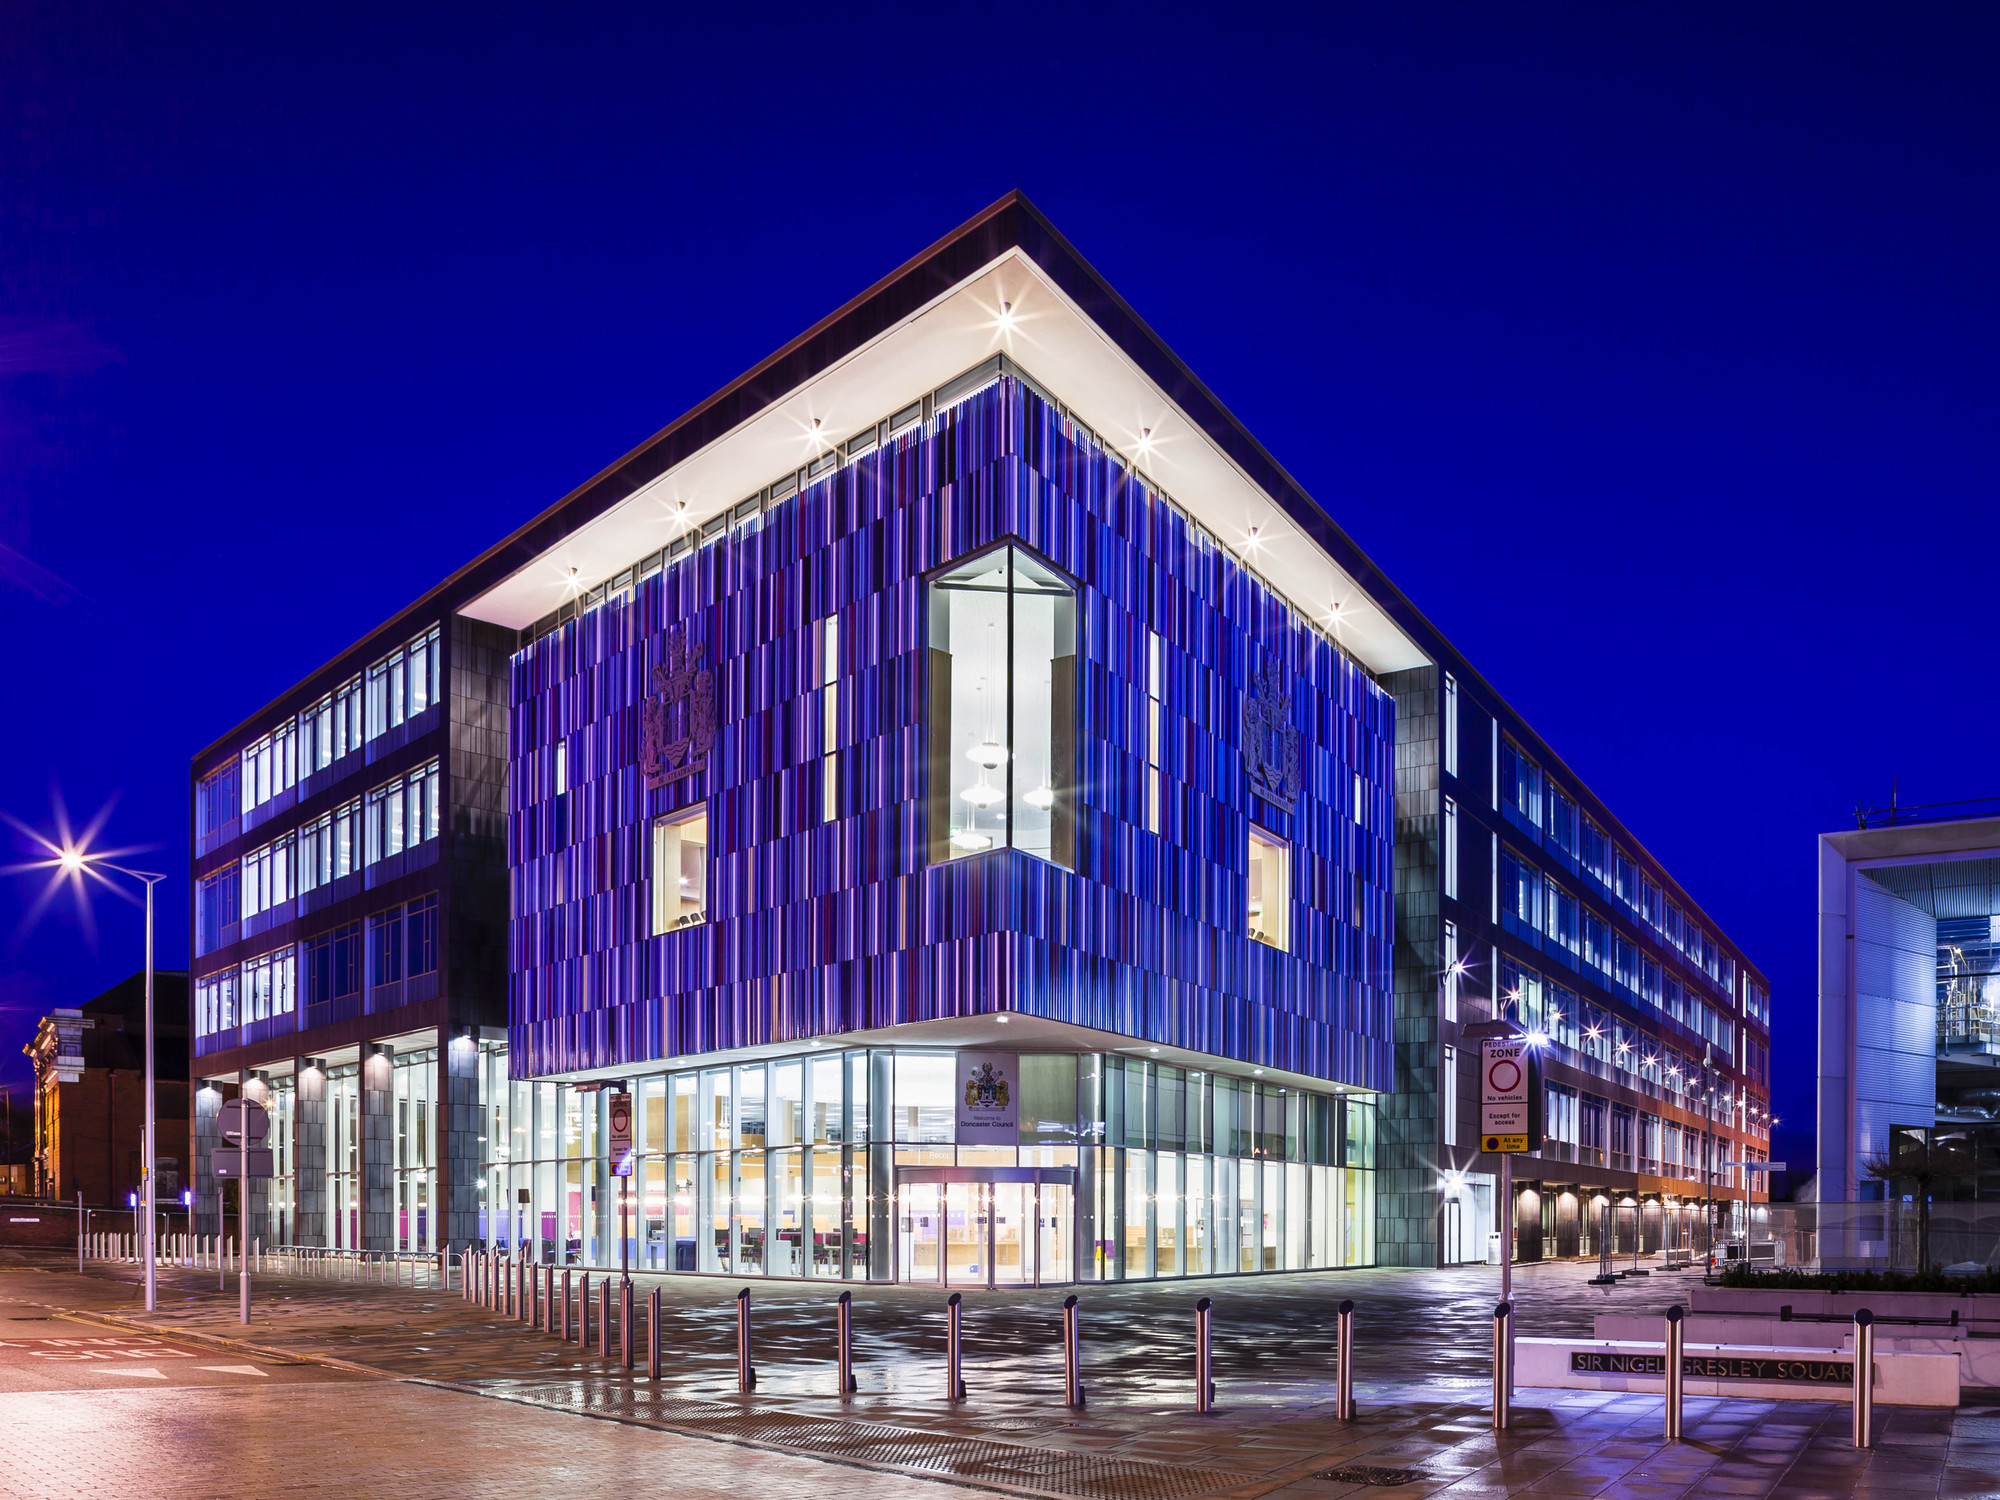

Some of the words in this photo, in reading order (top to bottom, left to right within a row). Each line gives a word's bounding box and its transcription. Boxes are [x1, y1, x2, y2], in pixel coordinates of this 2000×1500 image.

[1490, 1048, 1520, 1058] ZONE
[28, 1348, 198, 1360] BUS
[1577, 1354, 1603, 1371] SIR
[1610, 1355, 1666, 1373] NIGEL
[1683, 1358, 1767, 1378] GRESLEY
[1777, 1361, 1854, 1380] SQUAR
